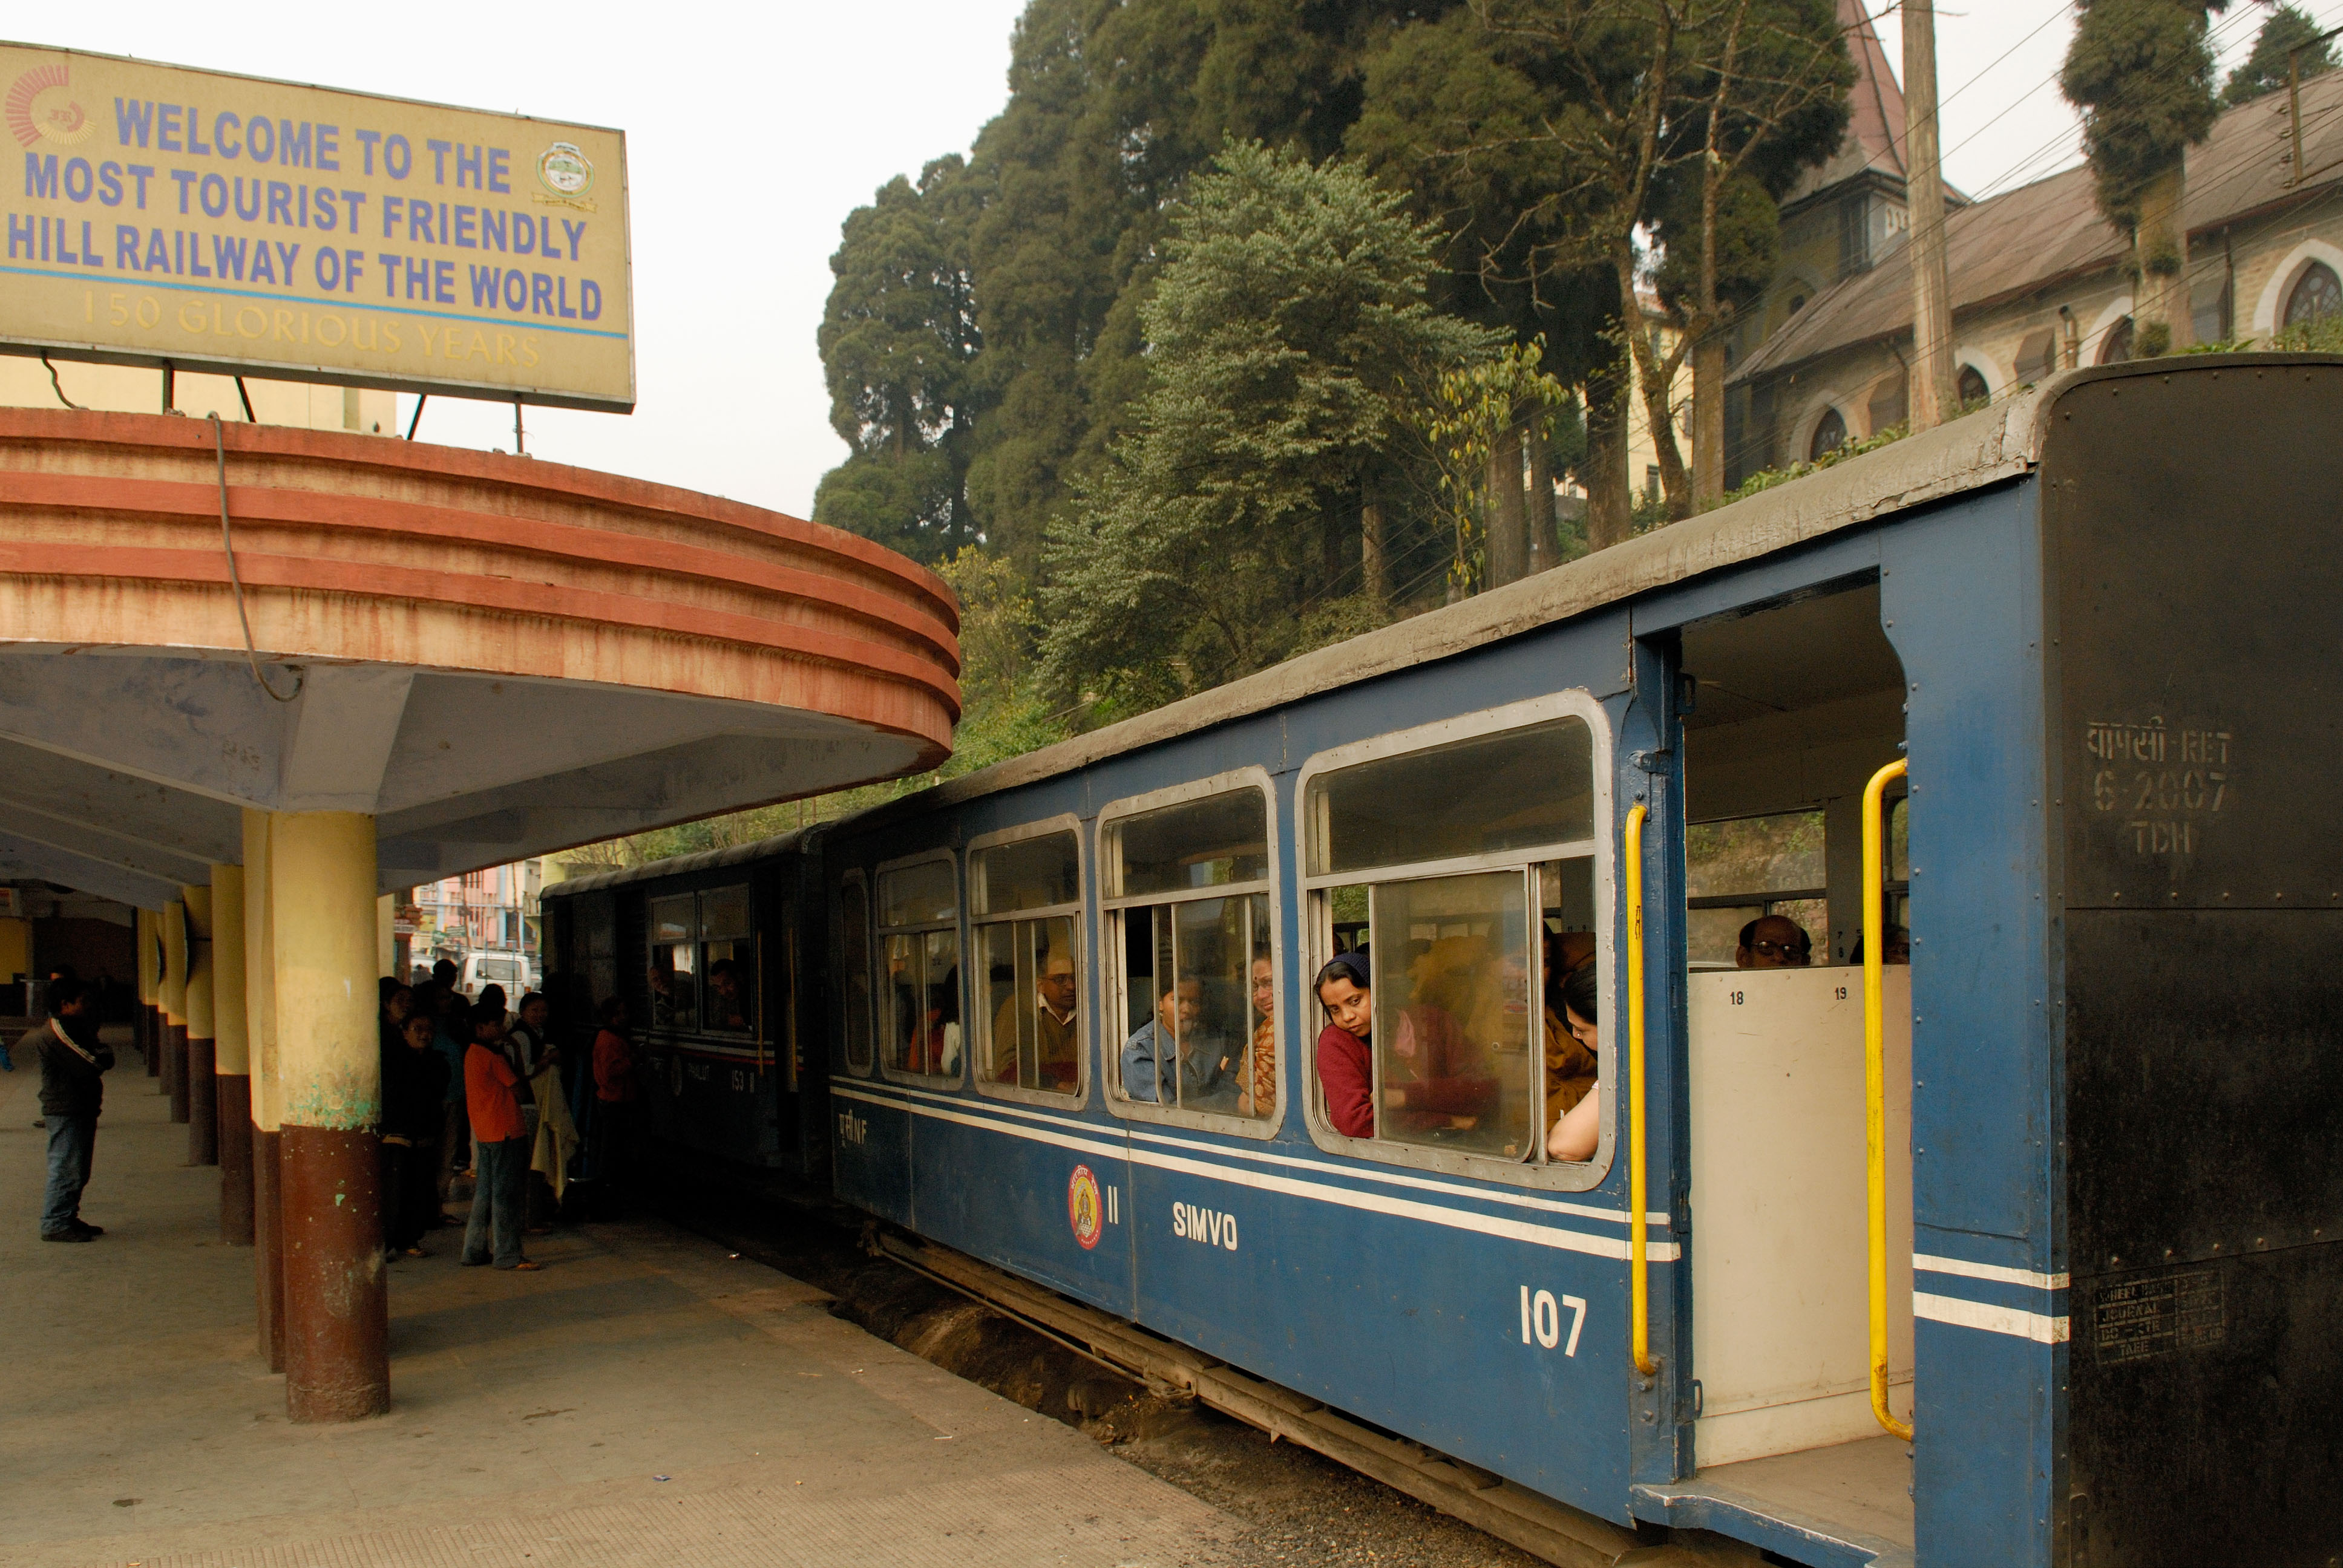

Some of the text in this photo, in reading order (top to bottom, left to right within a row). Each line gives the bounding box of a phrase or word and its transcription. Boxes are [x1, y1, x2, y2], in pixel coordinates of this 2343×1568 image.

[114, 97, 511, 194] WELCOME TO THE
[25, 152, 587, 261] MOST TOURIST FRIENDLY
[8, 213, 603, 321] HILL RAILWAY OF THE WORLD
[85, 290, 540, 368] 150 GLORIOUS YEARS
[2130, 820, 2191, 854] TDH
[1729, 991, 1743, 1005] 18
[1835, 987, 1847, 1000] 19
[1173, 1201, 1238, 1251] SIMVO
[1521, 1285, 1587, 1357] 107
[2103, 1301, 2160, 1322] JOURNAL
